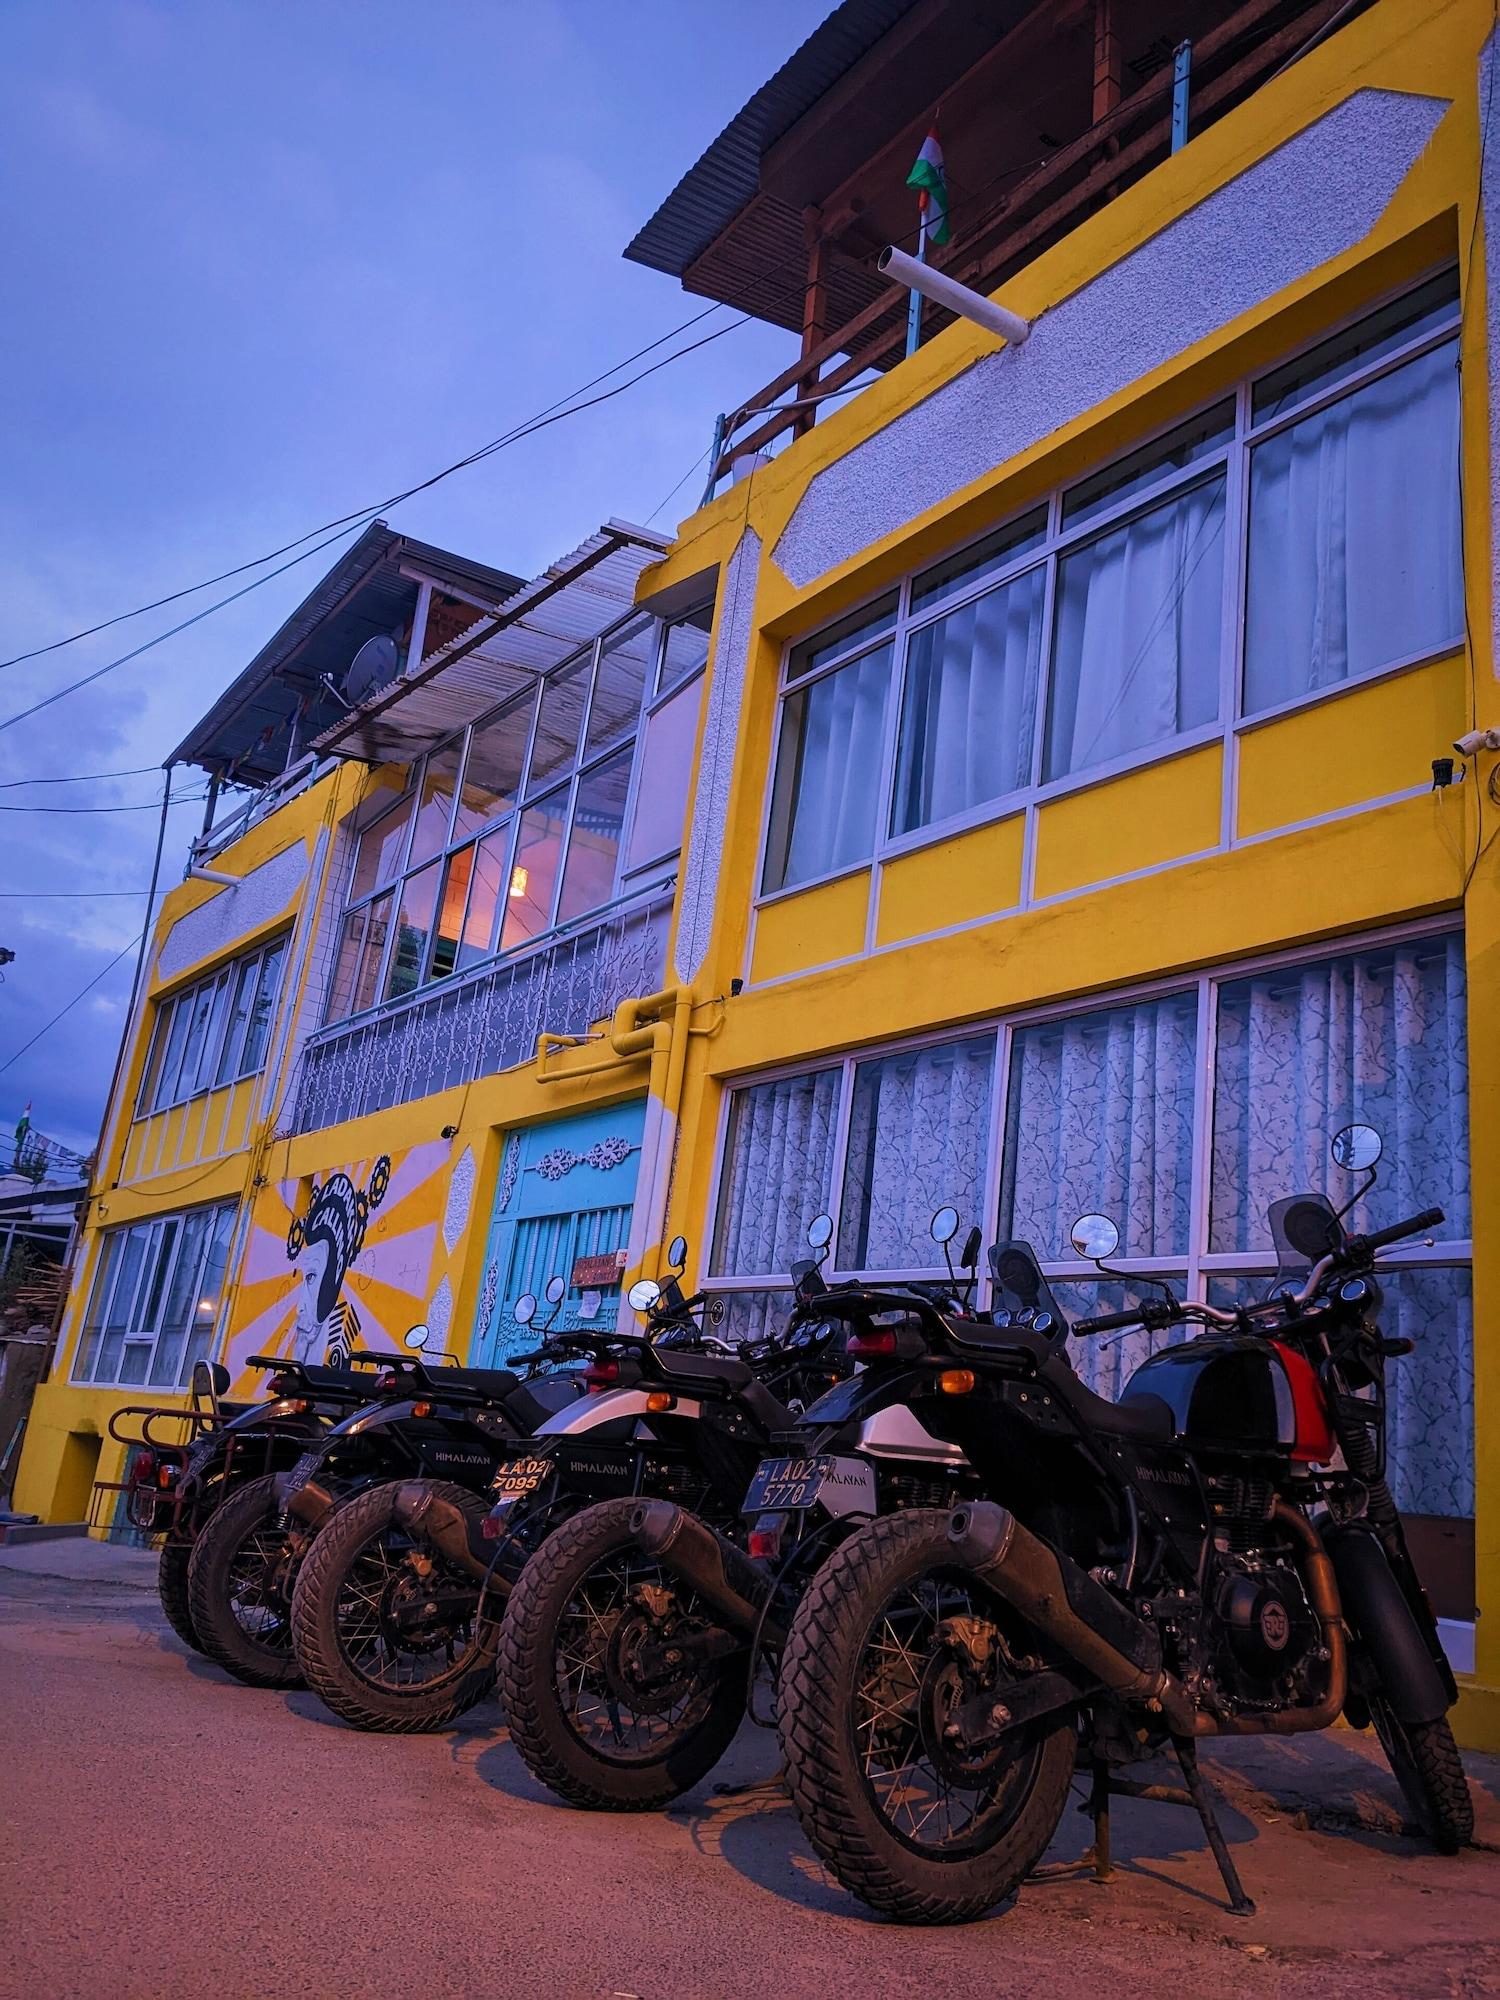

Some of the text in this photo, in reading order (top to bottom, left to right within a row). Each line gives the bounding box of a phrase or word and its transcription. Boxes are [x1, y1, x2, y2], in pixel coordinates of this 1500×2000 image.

[321, 1177, 356, 1253] LADAKH
[311, 1206, 344, 1284] CALLING
[435, 1452, 491, 1465] HIMALAYAN
[526, 1460, 546, 1473] 02
[570, 1461, 628, 1475] HIMALAYAN
[1135, 1465, 1190, 1486] HIMALAYAN
[493, 1476, 538, 1490] 7095
